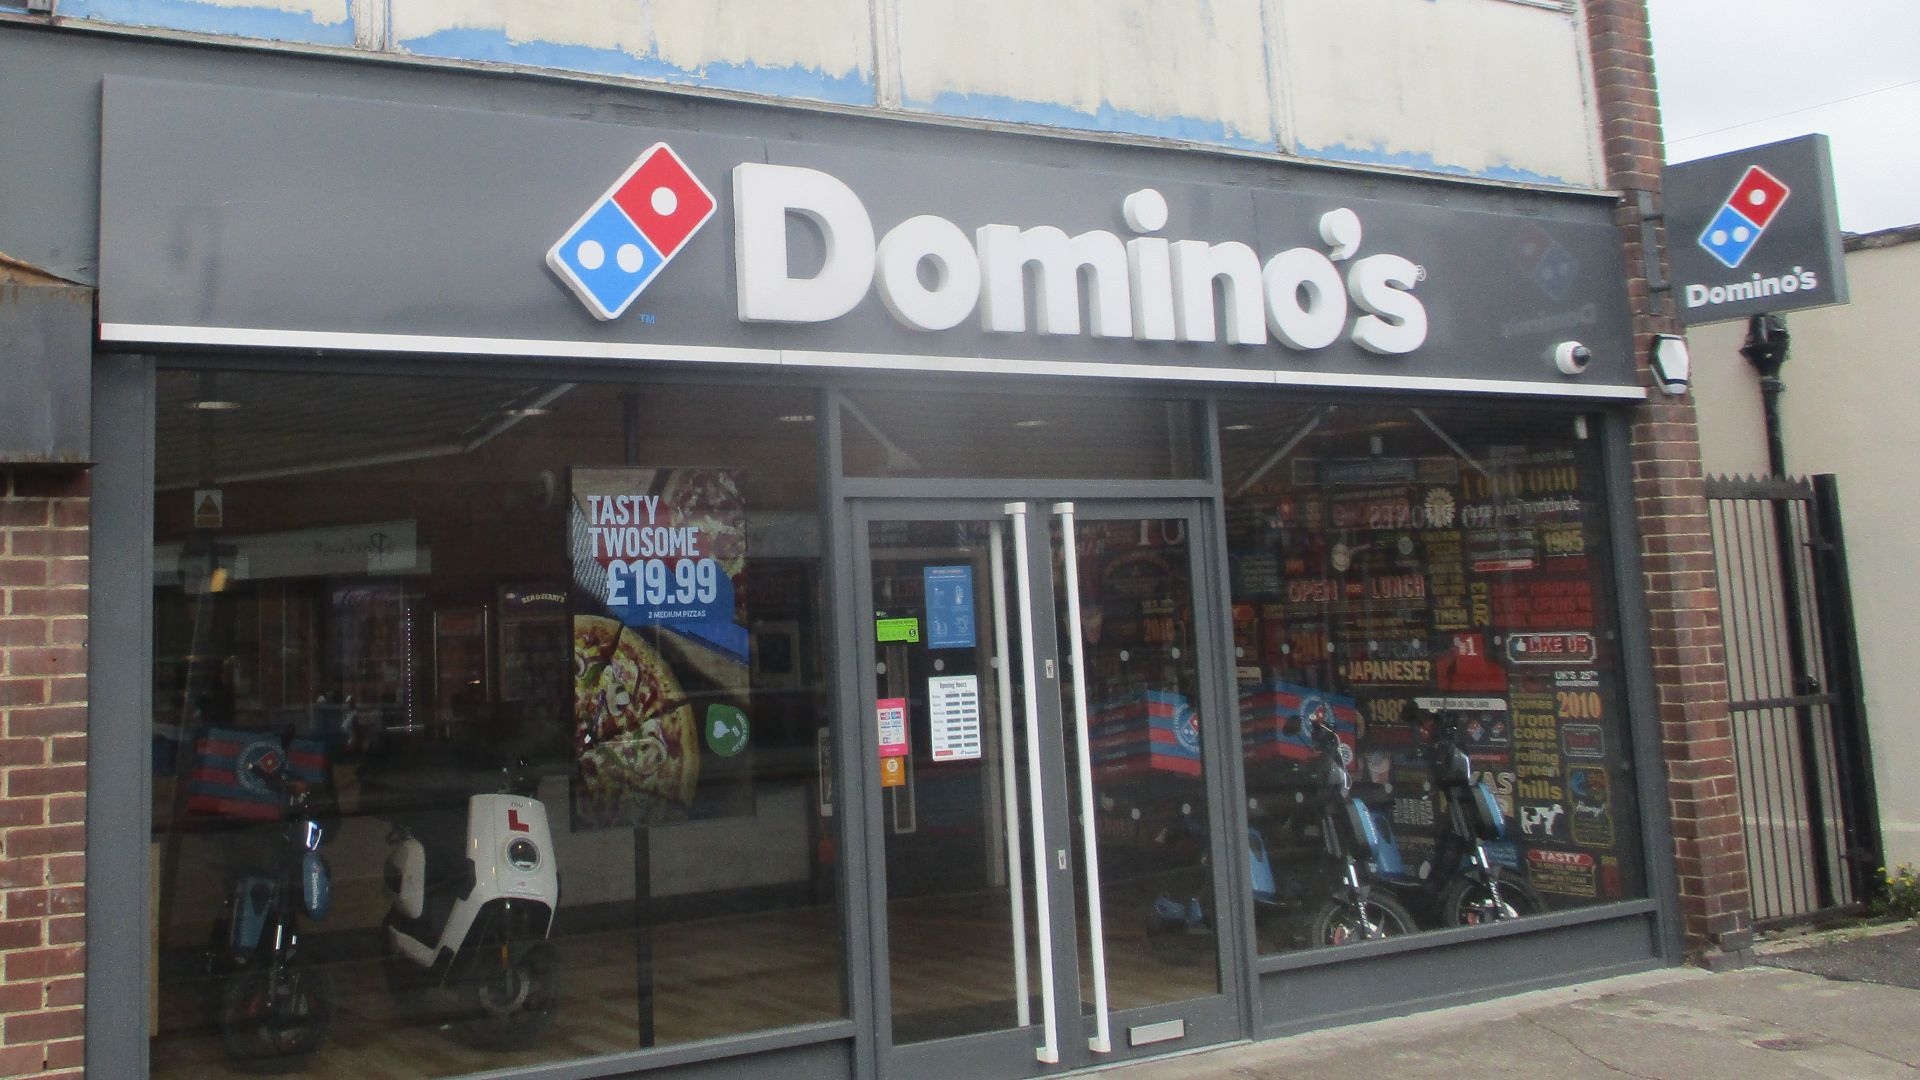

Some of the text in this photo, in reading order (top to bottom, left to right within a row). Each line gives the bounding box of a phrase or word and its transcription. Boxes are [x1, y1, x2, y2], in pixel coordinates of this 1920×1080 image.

[732, 162, 1428, 355] Domino's
[1686, 266, 1818, 308] Domino's
[587, 495, 660, 525] TASTY
[588, 527, 700, 558] TWOSOME
[606, 558, 717, 606] £19.99
[1371, 575, 1425, 599] LUNCH
[647, 610, 706, 619] 2 MEDIUM PIZZAS
[1529, 636, 1588, 653] LIKE US
[1348, 660, 1431, 682] JAPANESE?
[1557, 691, 1602, 719] 2010
[1513, 711, 1556, 727] from
[1514, 727, 1557, 740] cows
[1516, 749, 1560, 766] rolling
[1517, 765, 1560, 778] green
[1518, 779, 1563, 800] hills
[508, 809, 529, 833] L
[1539, 851, 1579, 864] TASTY
